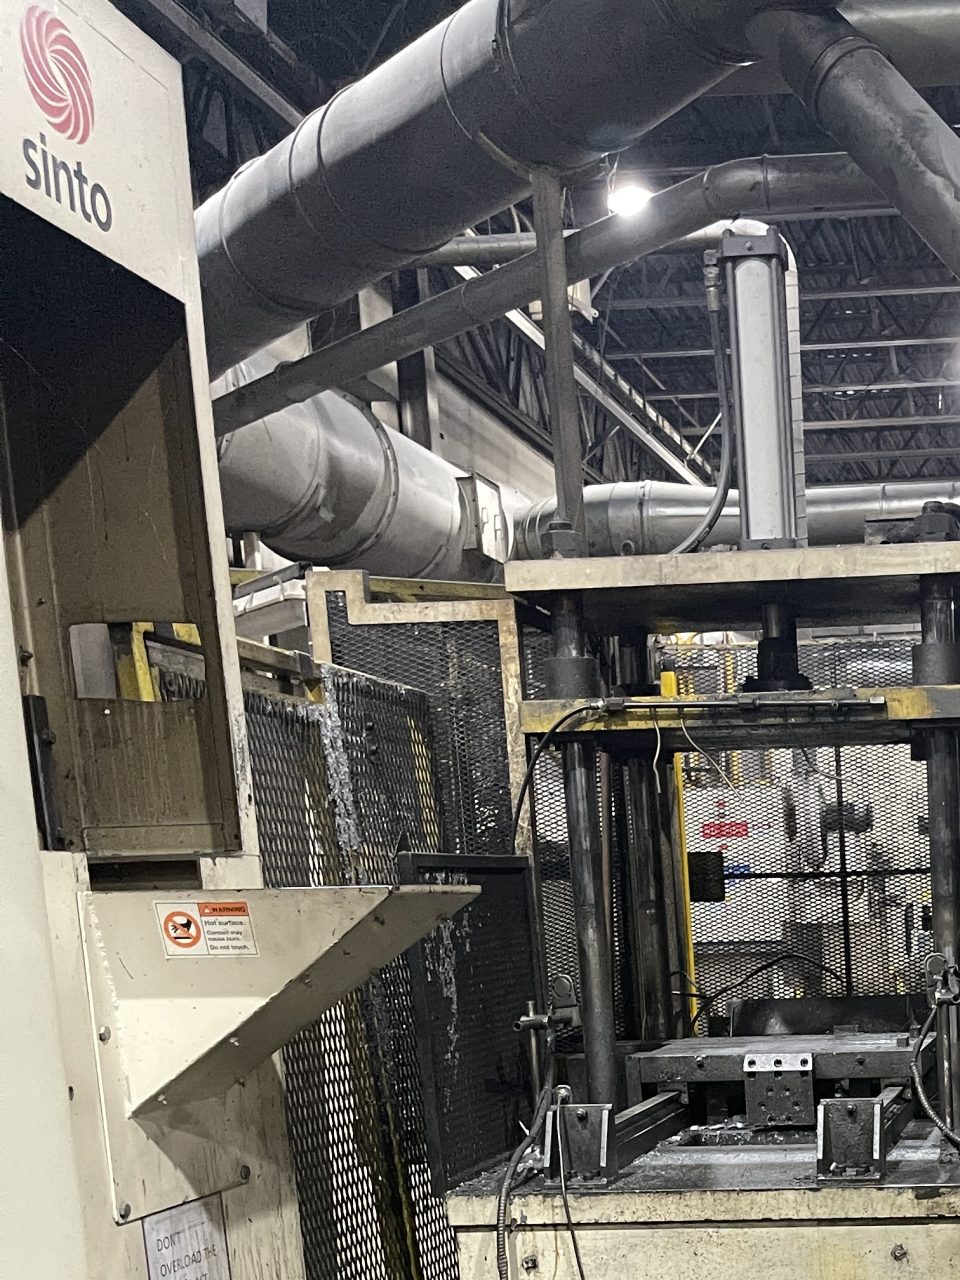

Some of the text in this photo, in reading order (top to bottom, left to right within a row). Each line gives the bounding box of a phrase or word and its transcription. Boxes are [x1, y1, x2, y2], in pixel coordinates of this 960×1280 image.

[22, 131, 112, 232] sinto
[211, 905, 246, 913] WARNING
[160, 1244, 217, 1277] OVERLOAD THE
